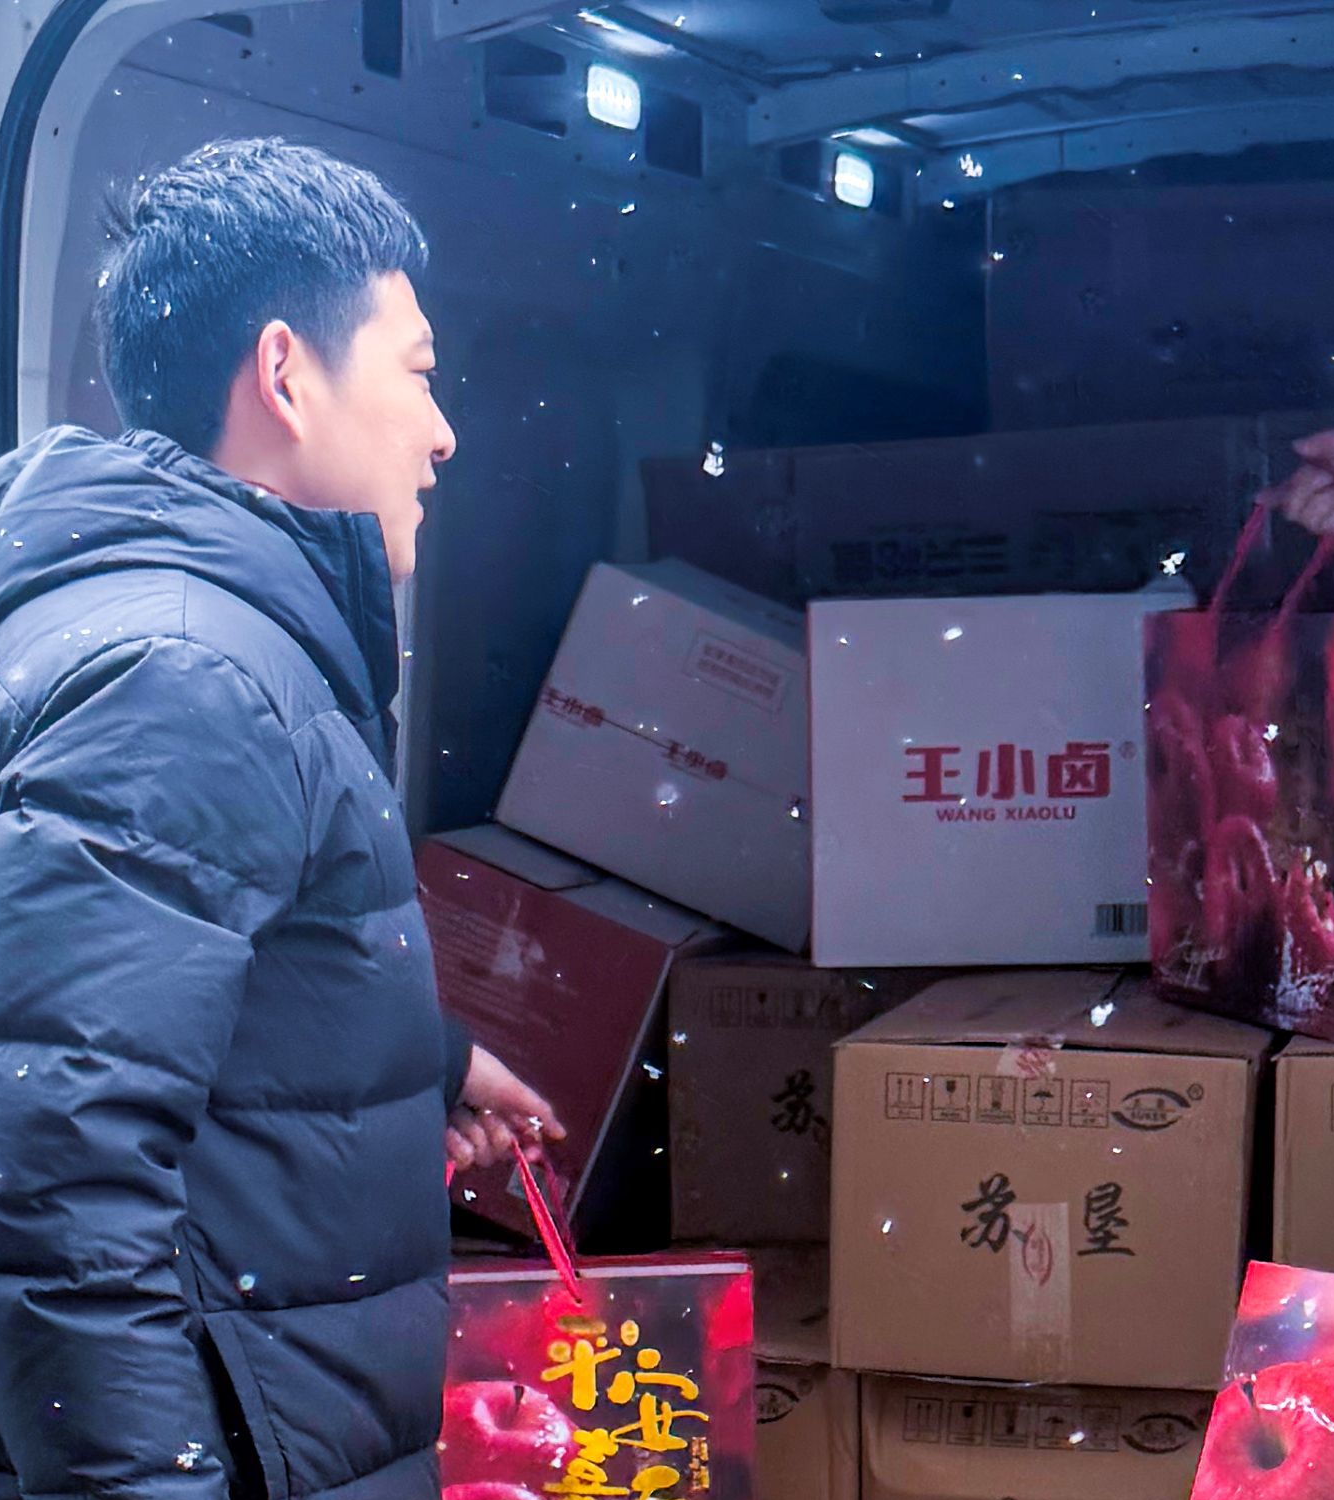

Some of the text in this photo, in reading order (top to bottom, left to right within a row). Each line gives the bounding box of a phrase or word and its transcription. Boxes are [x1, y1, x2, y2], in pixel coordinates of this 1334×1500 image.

[902, 742, 1110, 802] 王小卤
[936, 805, 1077, 822] WANG XIAOLU
[961, 1173, 1136, 1257] 苏垦
